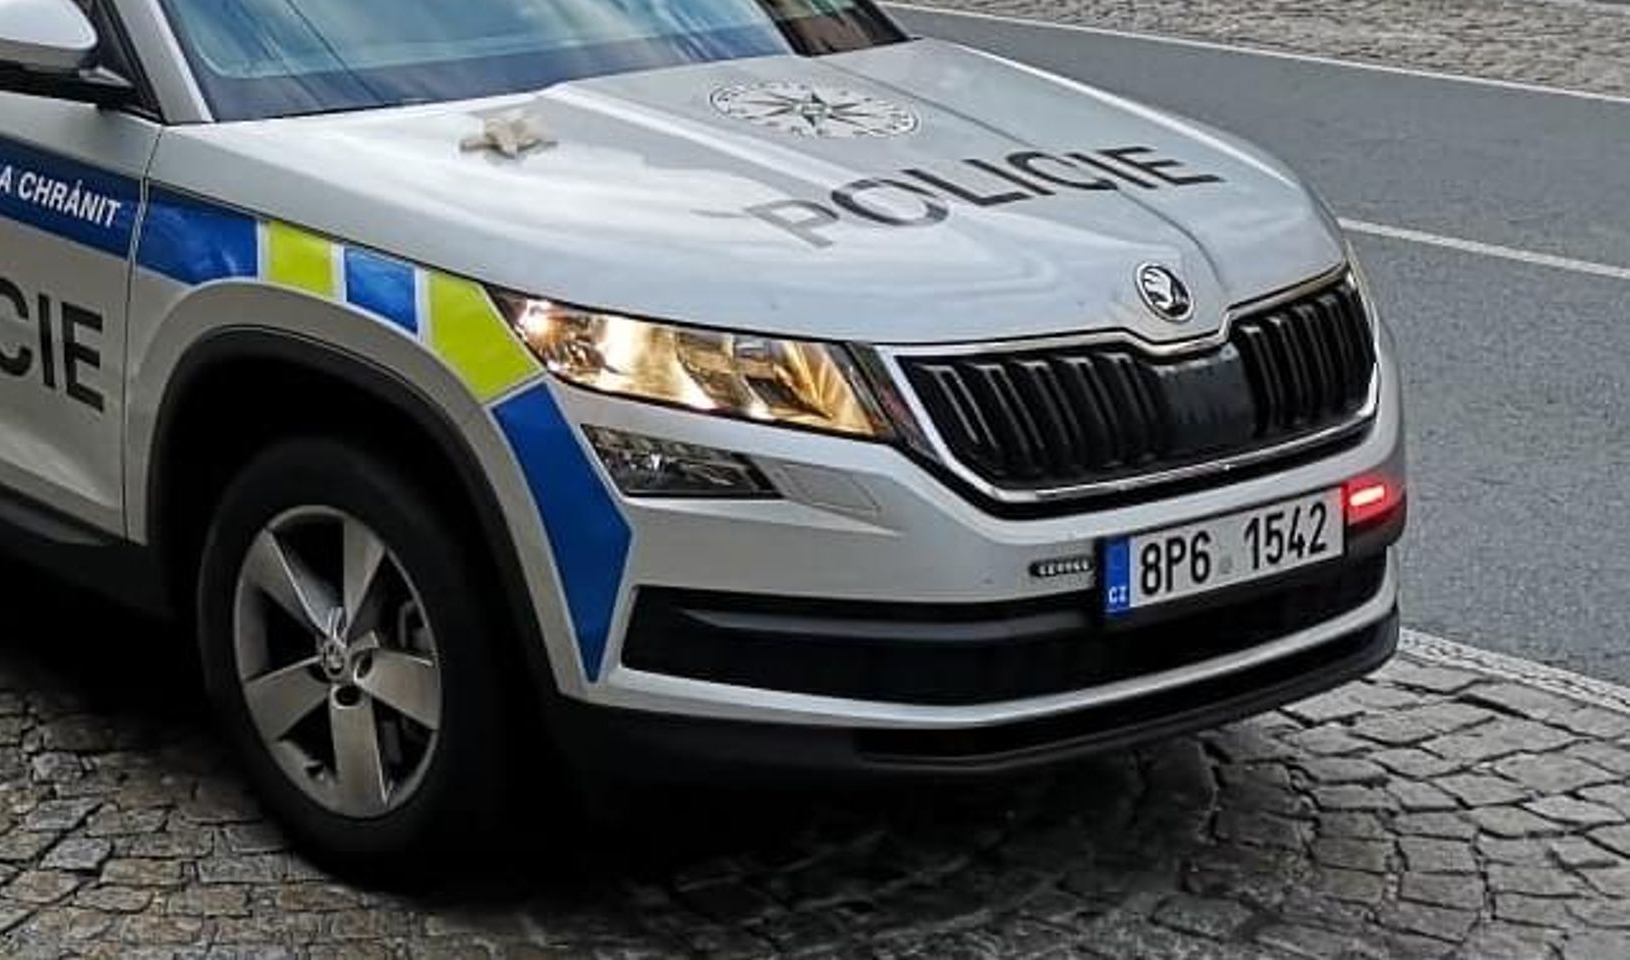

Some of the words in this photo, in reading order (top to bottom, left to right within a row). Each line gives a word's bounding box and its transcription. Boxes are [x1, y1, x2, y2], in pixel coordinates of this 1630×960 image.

[19, 171, 122, 229] CHRÁNIT
[745, 146, 1228, 249] POLICIE
[1140, 530, 1212, 596] 8P6
[1244, 501, 1328, 571] 1542
[1108, 584, 1128, 604] CZ
